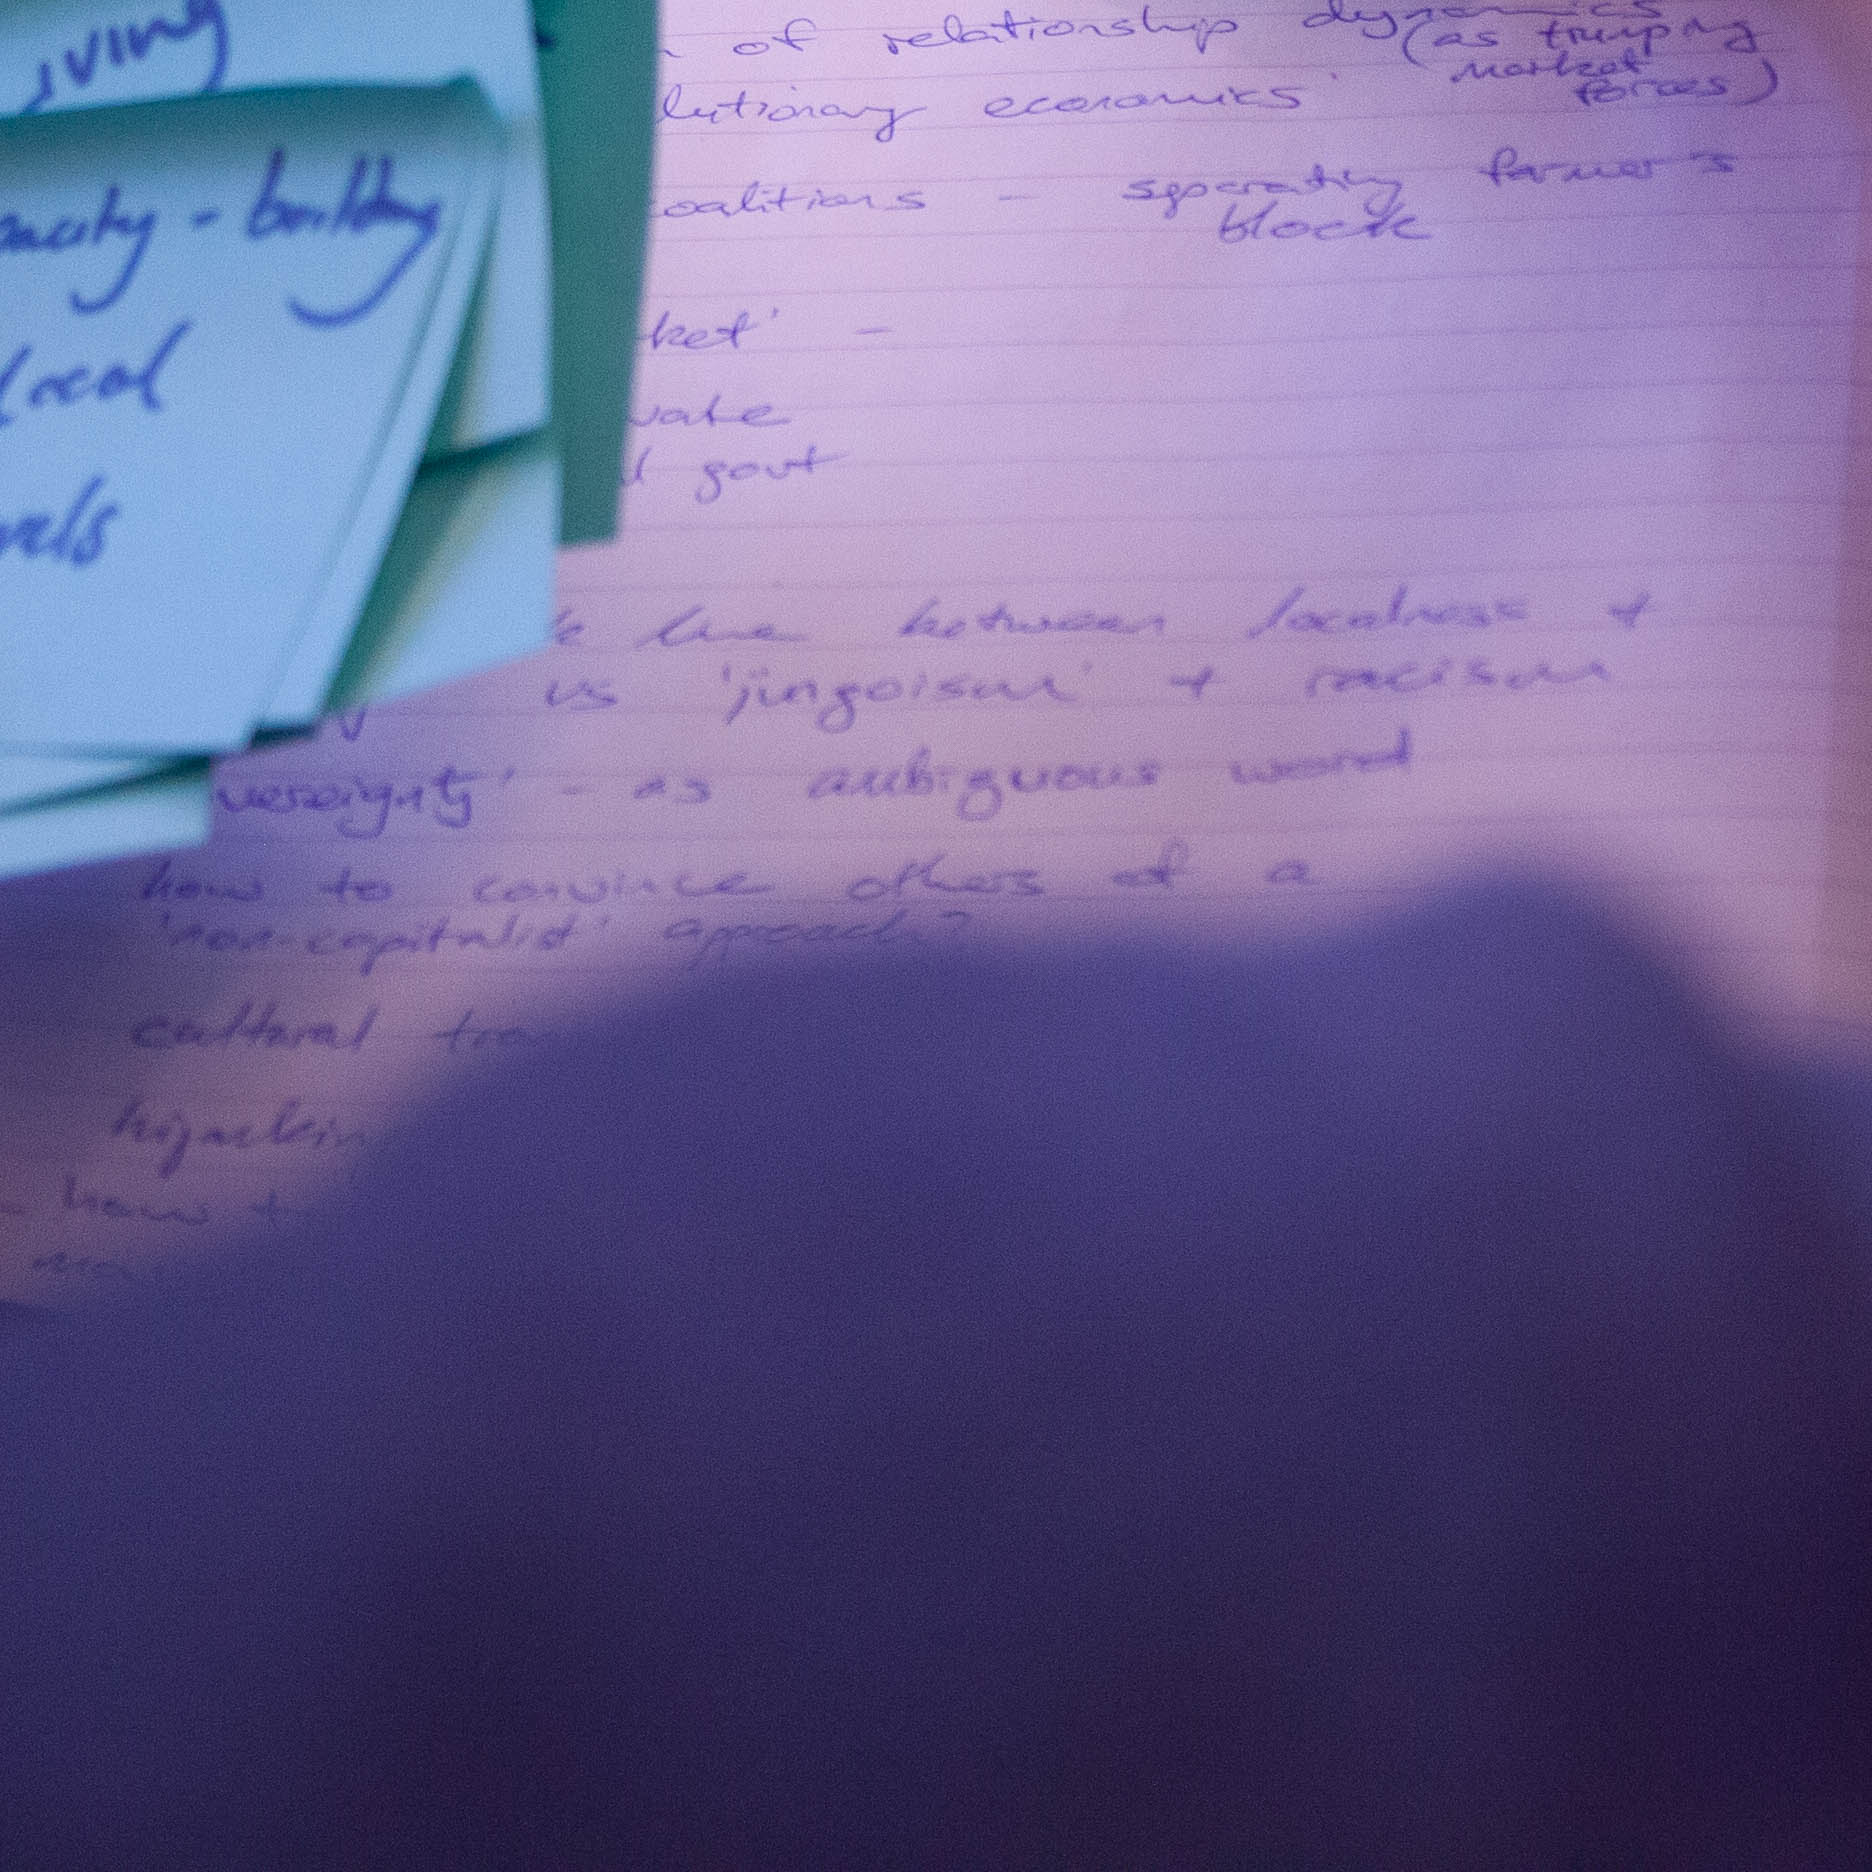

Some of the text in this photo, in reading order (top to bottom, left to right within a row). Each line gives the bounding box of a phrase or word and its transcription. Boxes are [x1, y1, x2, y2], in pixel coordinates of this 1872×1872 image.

[731, 16, 820, 57] of
[881, 4, 1240, 56] relationship
[658, 82, 929, 144] lutionary
[658, 179, 928, 220] oalitions
[899, 596, 1166, 640] between
[1304, 657, 1610, 698] racism
[633, 777, 712, 804] as
[807, 745, 1163, 823] ambiguous
[1229, 727, 1415, 786] word
[139, 860, 265, 903] how
[326, 867, 394, 904] to
[472, 866, 776, 905] convince
[1110, 836, 1189, 889] of
[1265, 859, 1320, 886] a
[131, 1001, 380, 1052] cultural
